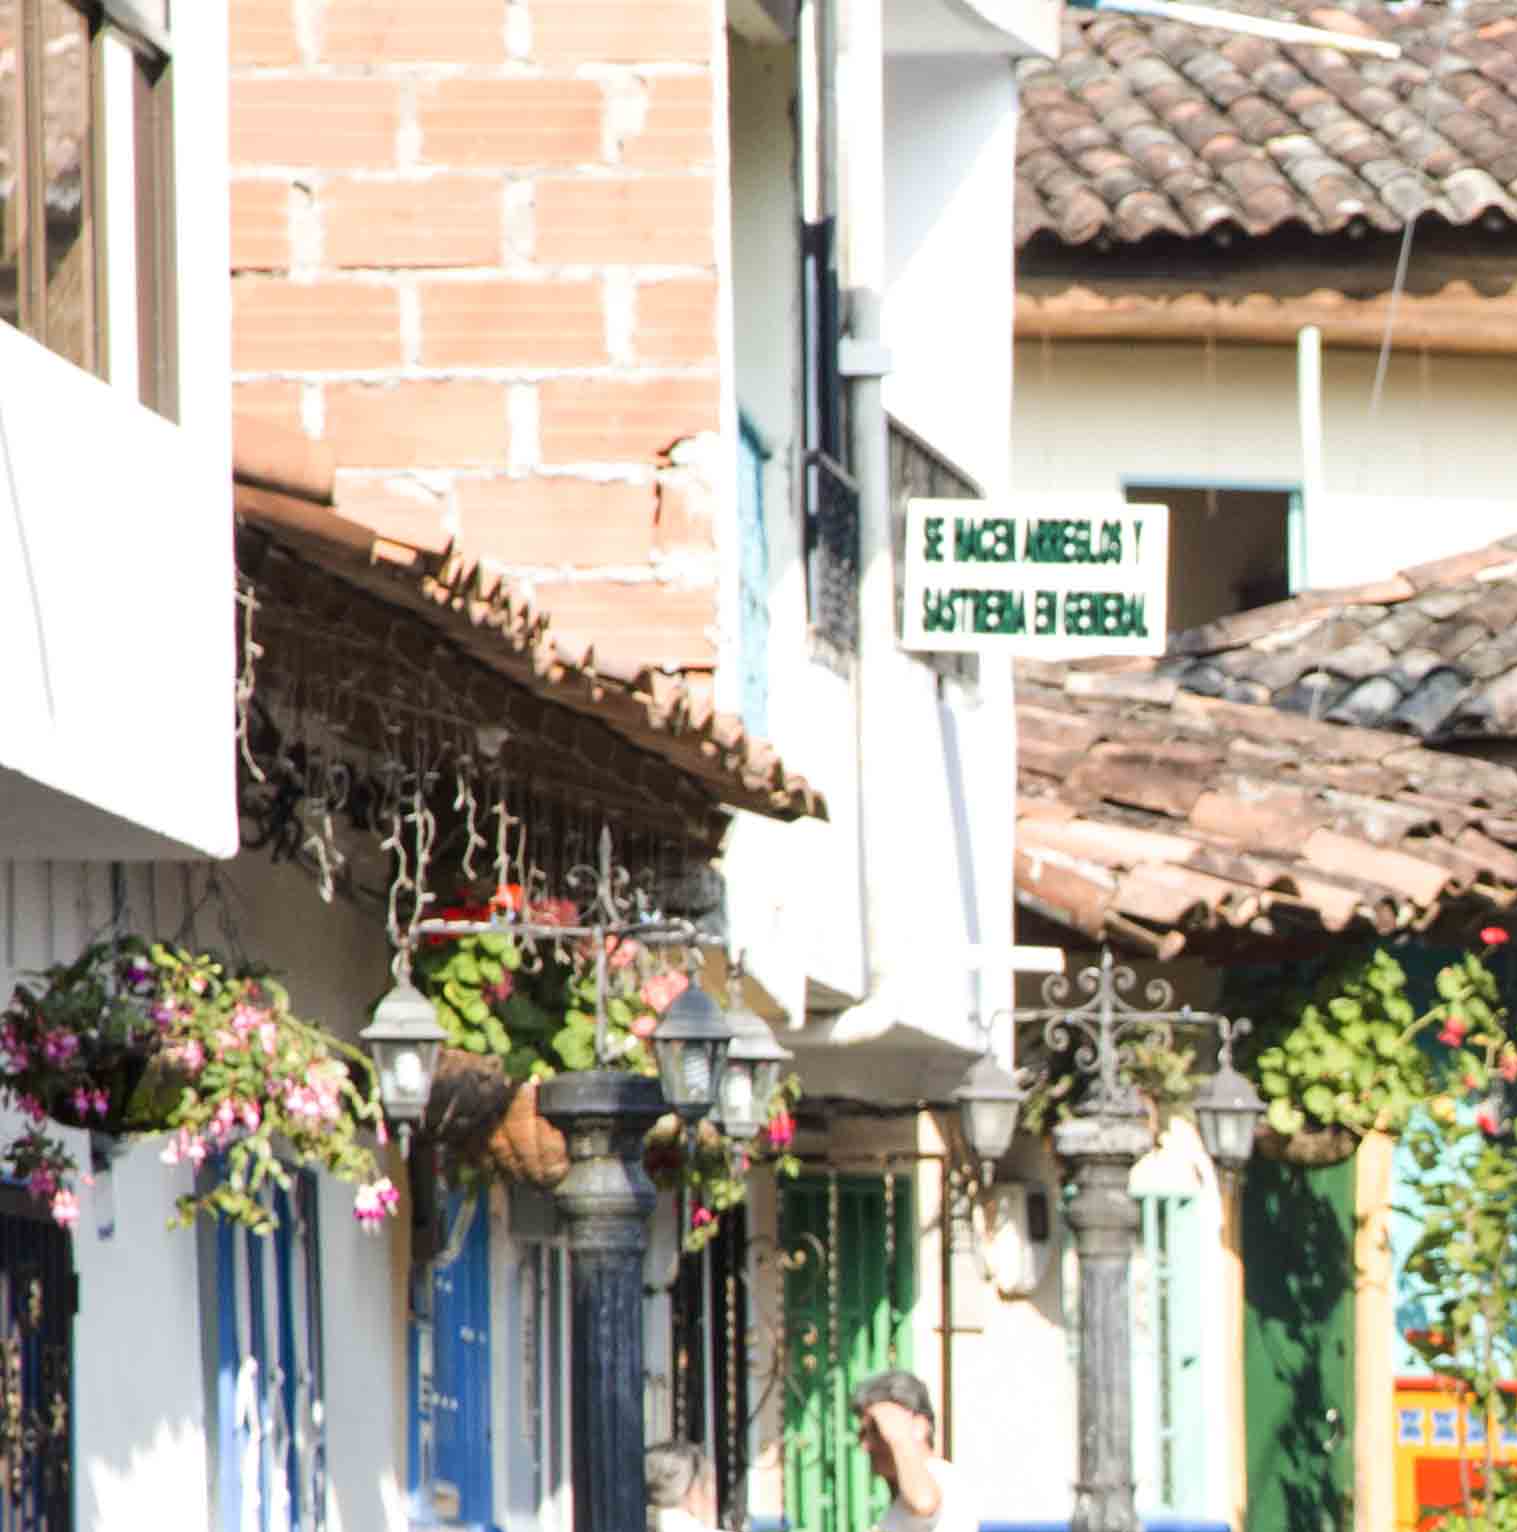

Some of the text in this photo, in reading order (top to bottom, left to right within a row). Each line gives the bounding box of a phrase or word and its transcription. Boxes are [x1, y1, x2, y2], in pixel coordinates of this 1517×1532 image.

[953, 517, 1016, 563] HACEN
[1022, 518, 1122, 564] ARREGLOS
[1133, 519, 1144, 564] Y
[1034, 589, 1058, 635] EN
[1064, 590, 1150, 638] GENERAL
